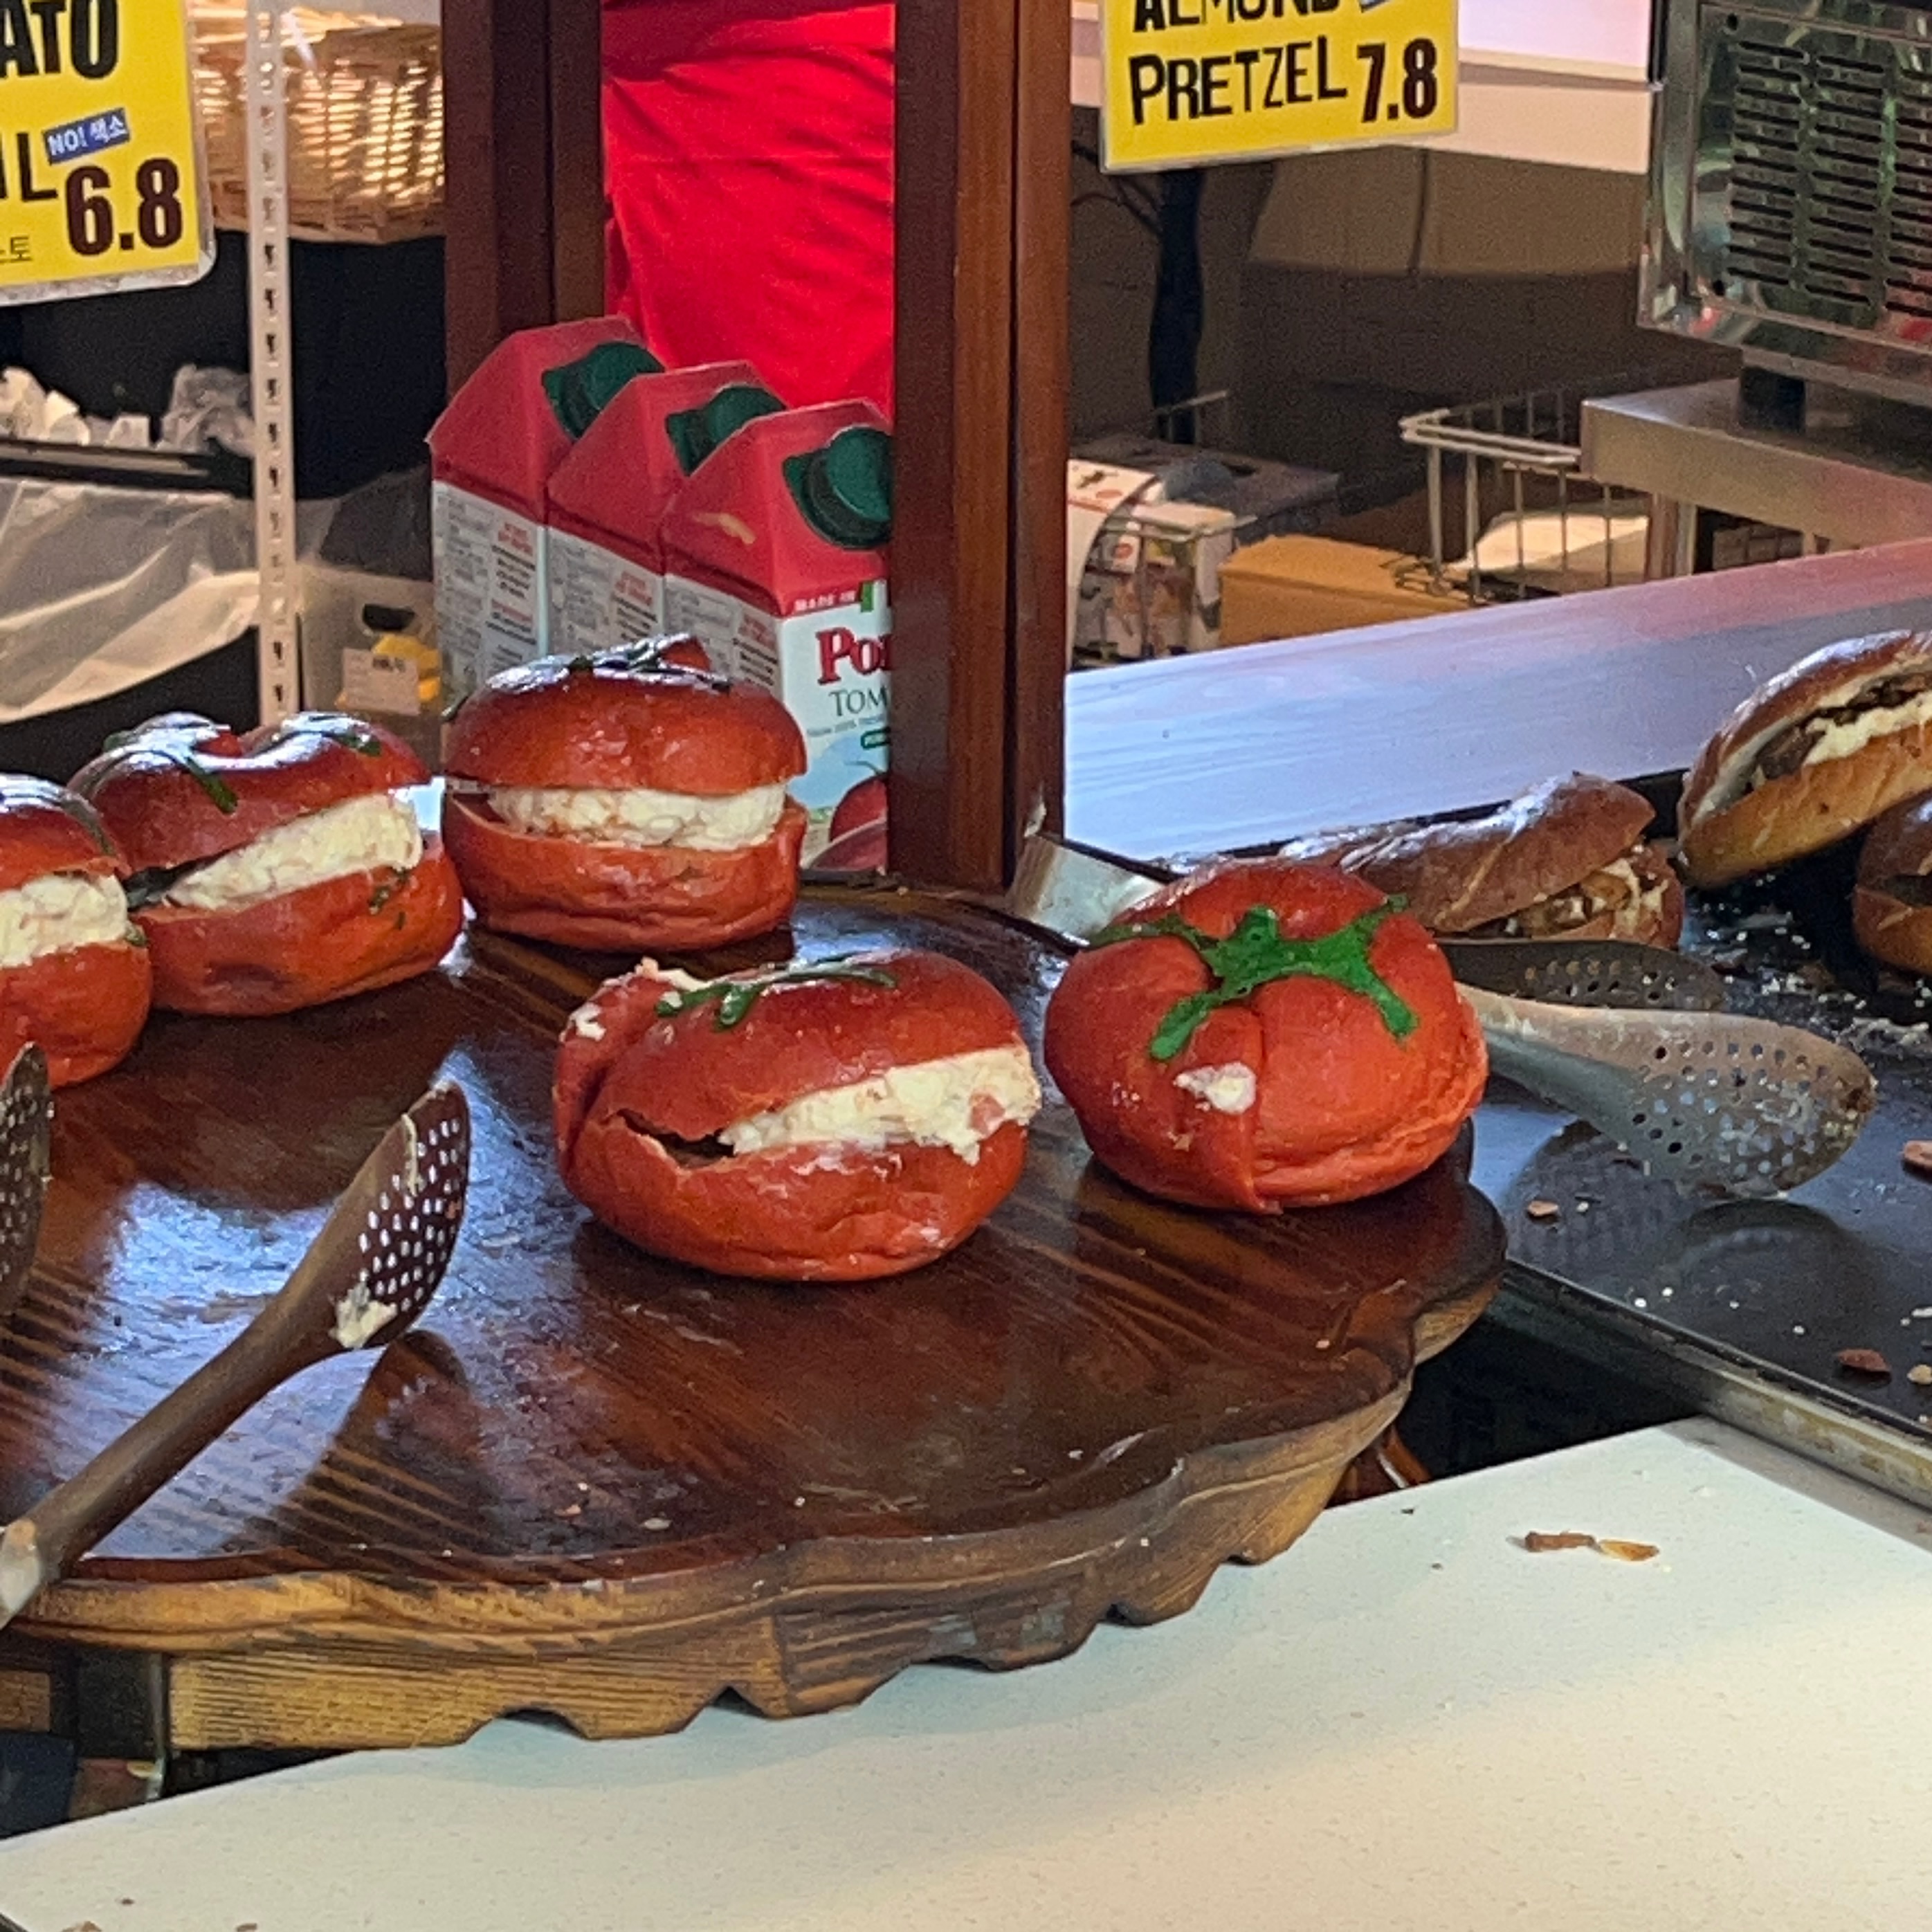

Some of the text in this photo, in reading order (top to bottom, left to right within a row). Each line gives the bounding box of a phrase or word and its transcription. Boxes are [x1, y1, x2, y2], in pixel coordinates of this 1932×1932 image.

[1129, 35, 1437, 125] PRETZEL 7.8
[48, 126, 88, 156] NO!
[66, 158, 183, 255] 6.8
